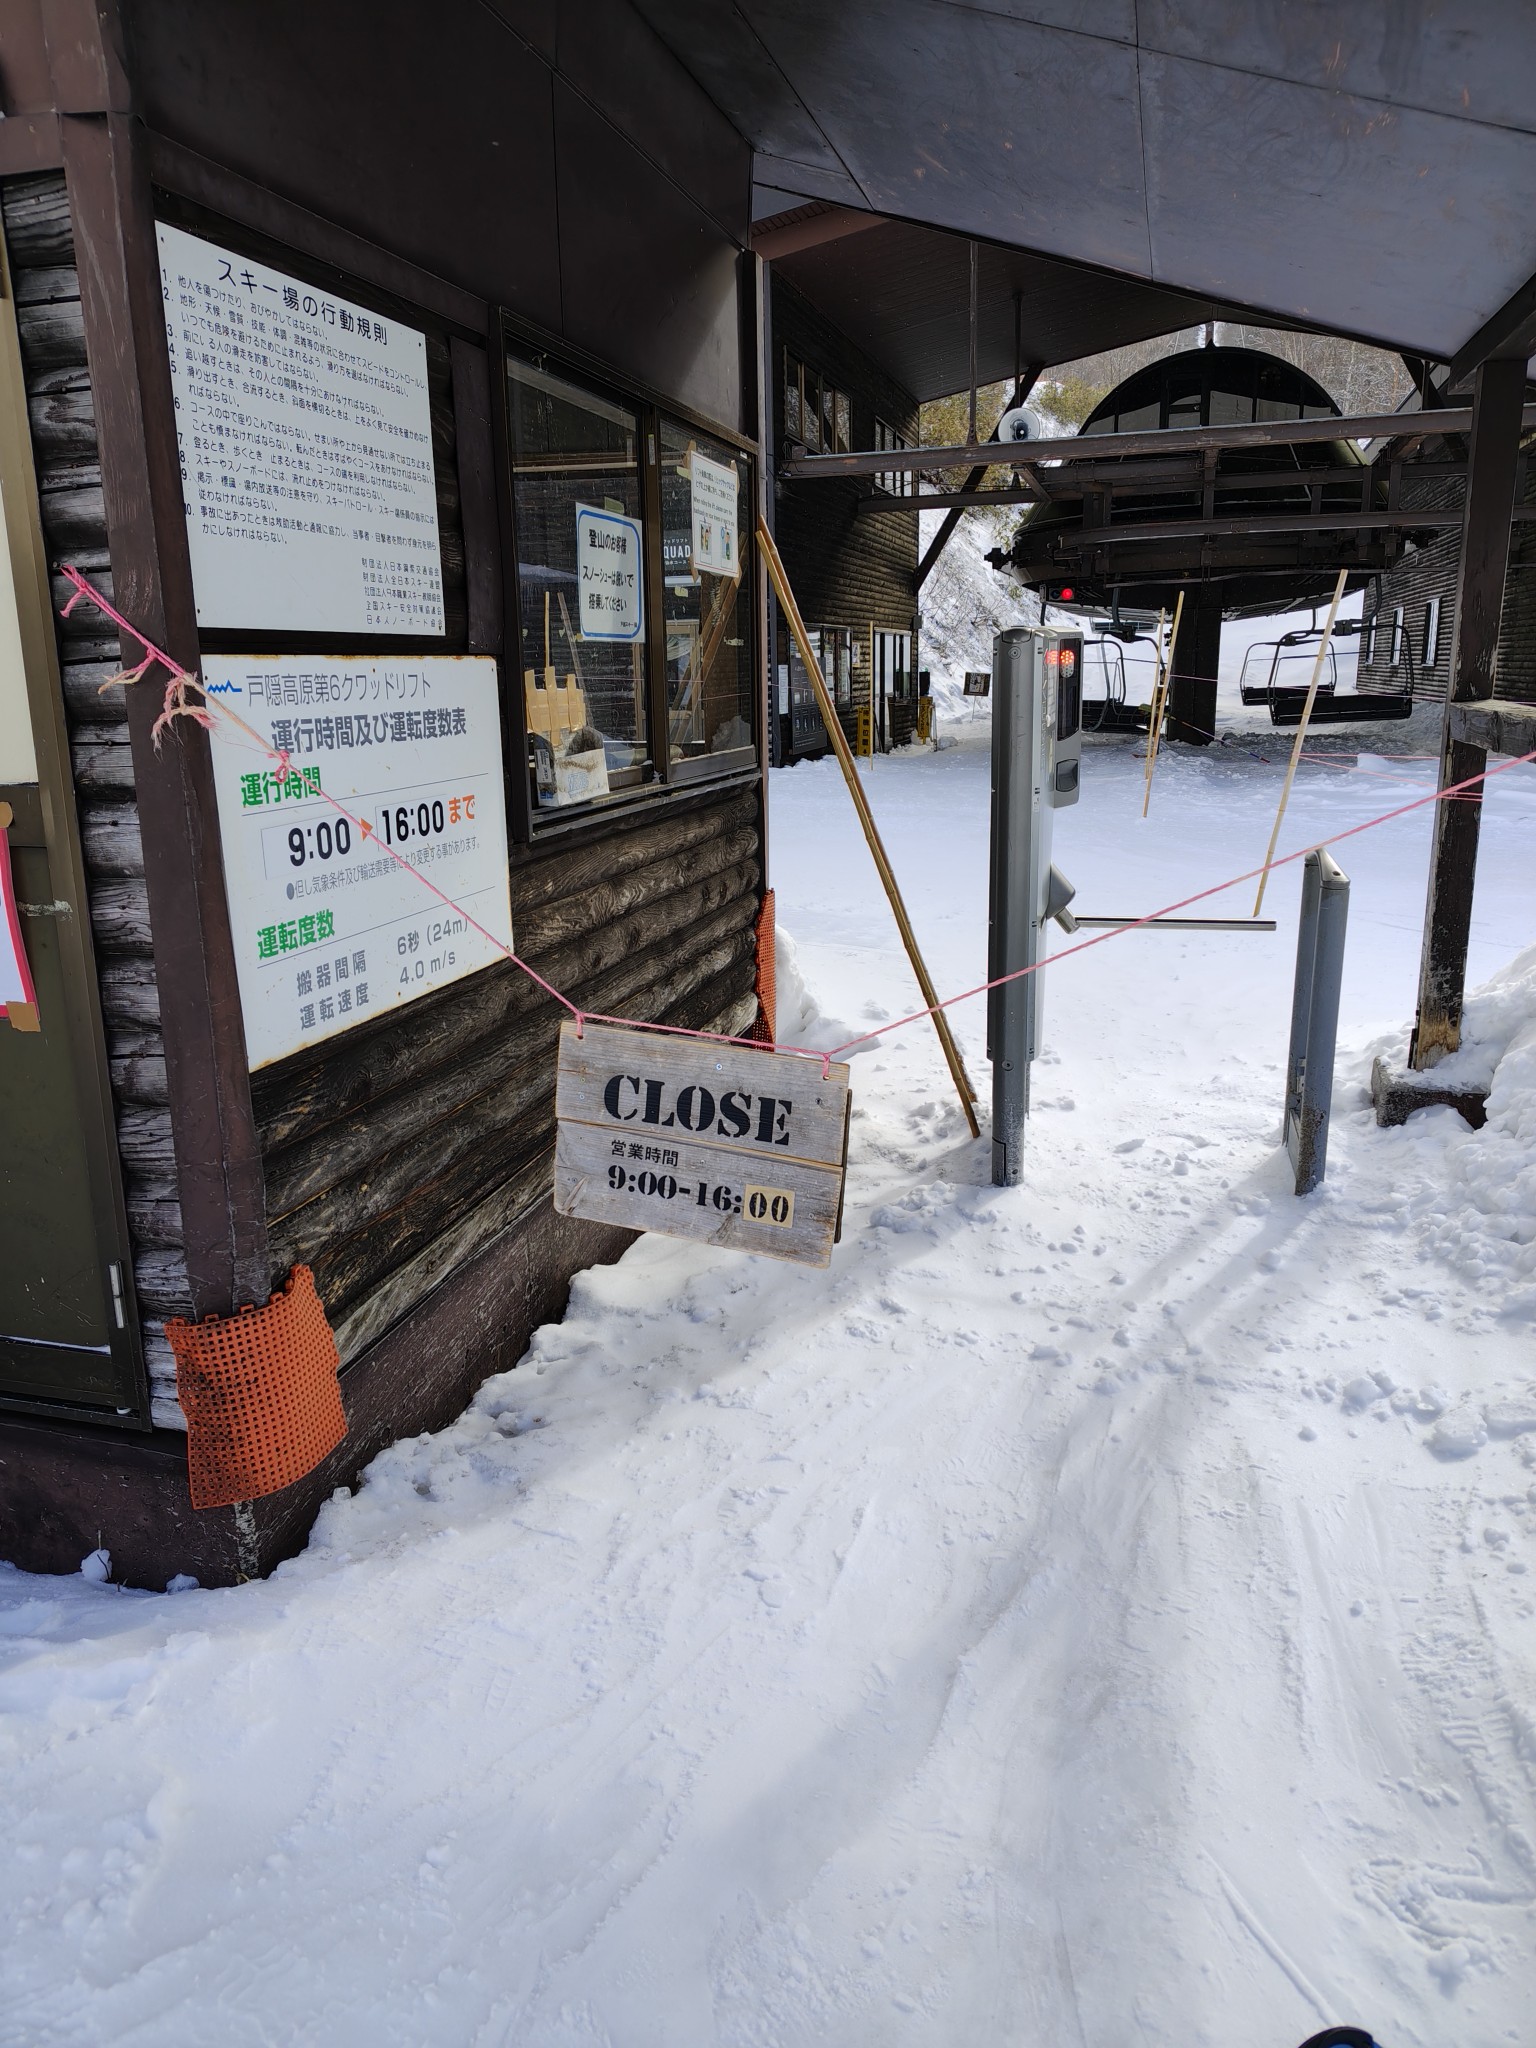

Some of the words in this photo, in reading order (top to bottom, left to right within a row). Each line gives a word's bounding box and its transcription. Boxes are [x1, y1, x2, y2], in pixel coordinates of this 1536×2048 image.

[176, 273, 327, 341] 他人を傷つけたり、おびやかしてはならない。
[216, 256, 388, 347] スキー場の行動規則
[188, 382, 239, 408] ればならない。
[198, 487, 277, 512] 従わなければならない。
[201, 522, 287, 544] かにしなければならない。
[588, 527, 627, 555] 登山のお客様
[664, 544, 691, 559] QUAD
[245, 671, 431, 707] 戸隠高原第6クワッドリフト
[269, 706, 467, 755] 運行時間及び運転度数表
[239, 765, 322, 808] 運行時間
[286, 817, 352, 867] 9:00
[381, 799, 445, 845] 16:00
[447, 793, 476, 824] まで
[293, 835, 480, 899] 但し気象条件及び輸送需要等により変更する事があります。
[256, 908, 335, 960] 運転度数
[295, 949, 367, 997] 搬器間隔
[396, 929, 420, 957] 6秒
[426, 911, 468, 946] (24m)
[299, 980, 369, 1031] 運転速度
[398, 959, 424, 986] 4.0
[429, 946, 456, 973] m/s
[603, 1074, 792, 1146] CLOSE
[611, 1140, 679, 1167] 営業時間
[608, 1164, 790, 1223] 9:00-16:00
